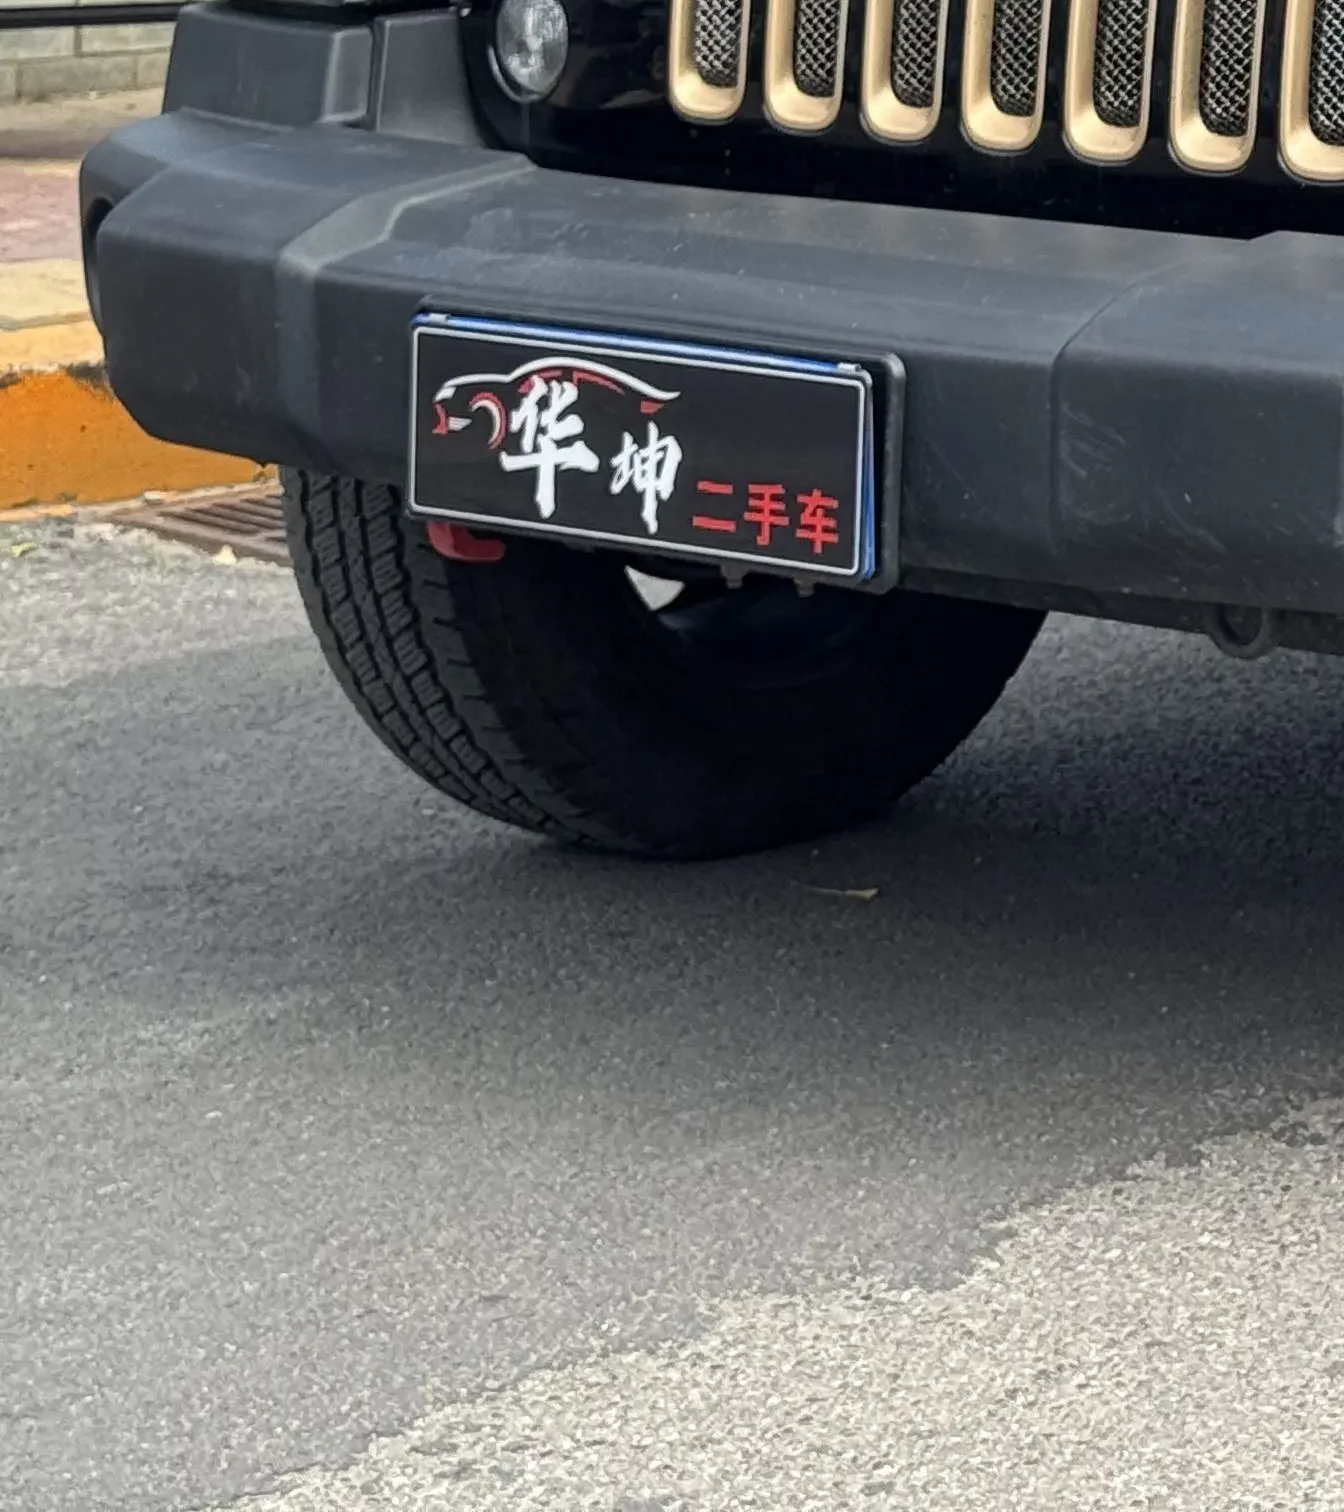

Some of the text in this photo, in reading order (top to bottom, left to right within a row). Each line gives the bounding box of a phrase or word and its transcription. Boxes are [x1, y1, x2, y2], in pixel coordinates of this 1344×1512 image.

[499, 374, 840, 555] 华坤 二手车
